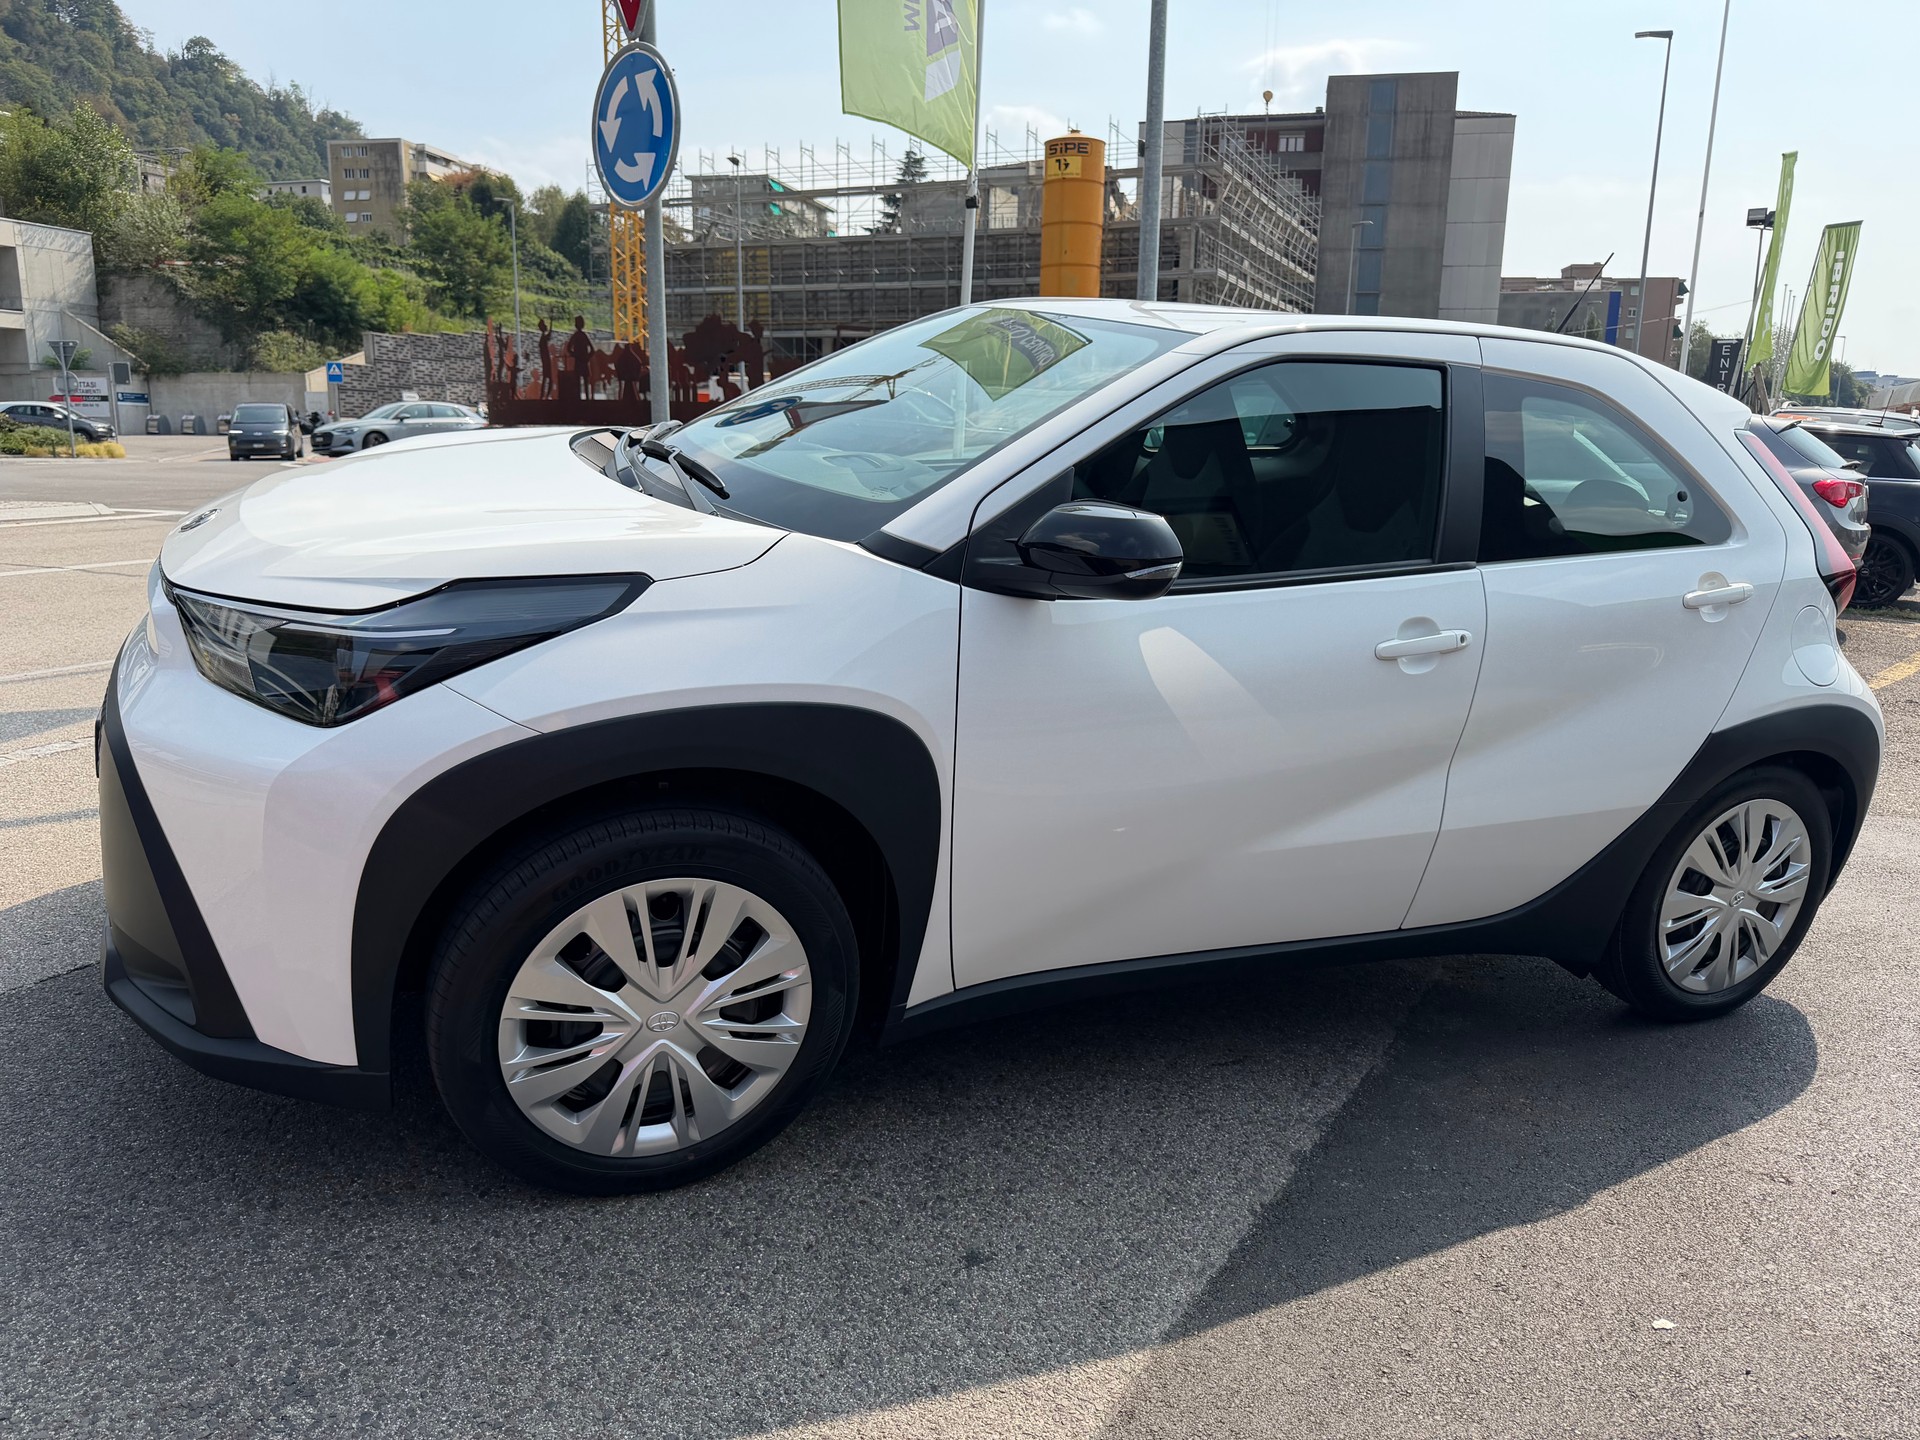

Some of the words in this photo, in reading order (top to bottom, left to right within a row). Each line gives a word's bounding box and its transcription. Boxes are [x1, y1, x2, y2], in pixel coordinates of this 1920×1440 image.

[1814, 251, 1845, 361] IBRIDO
[1019, 335, 1056, 366] CENTRO
[1717, 345, 1731, 393] ENTR
